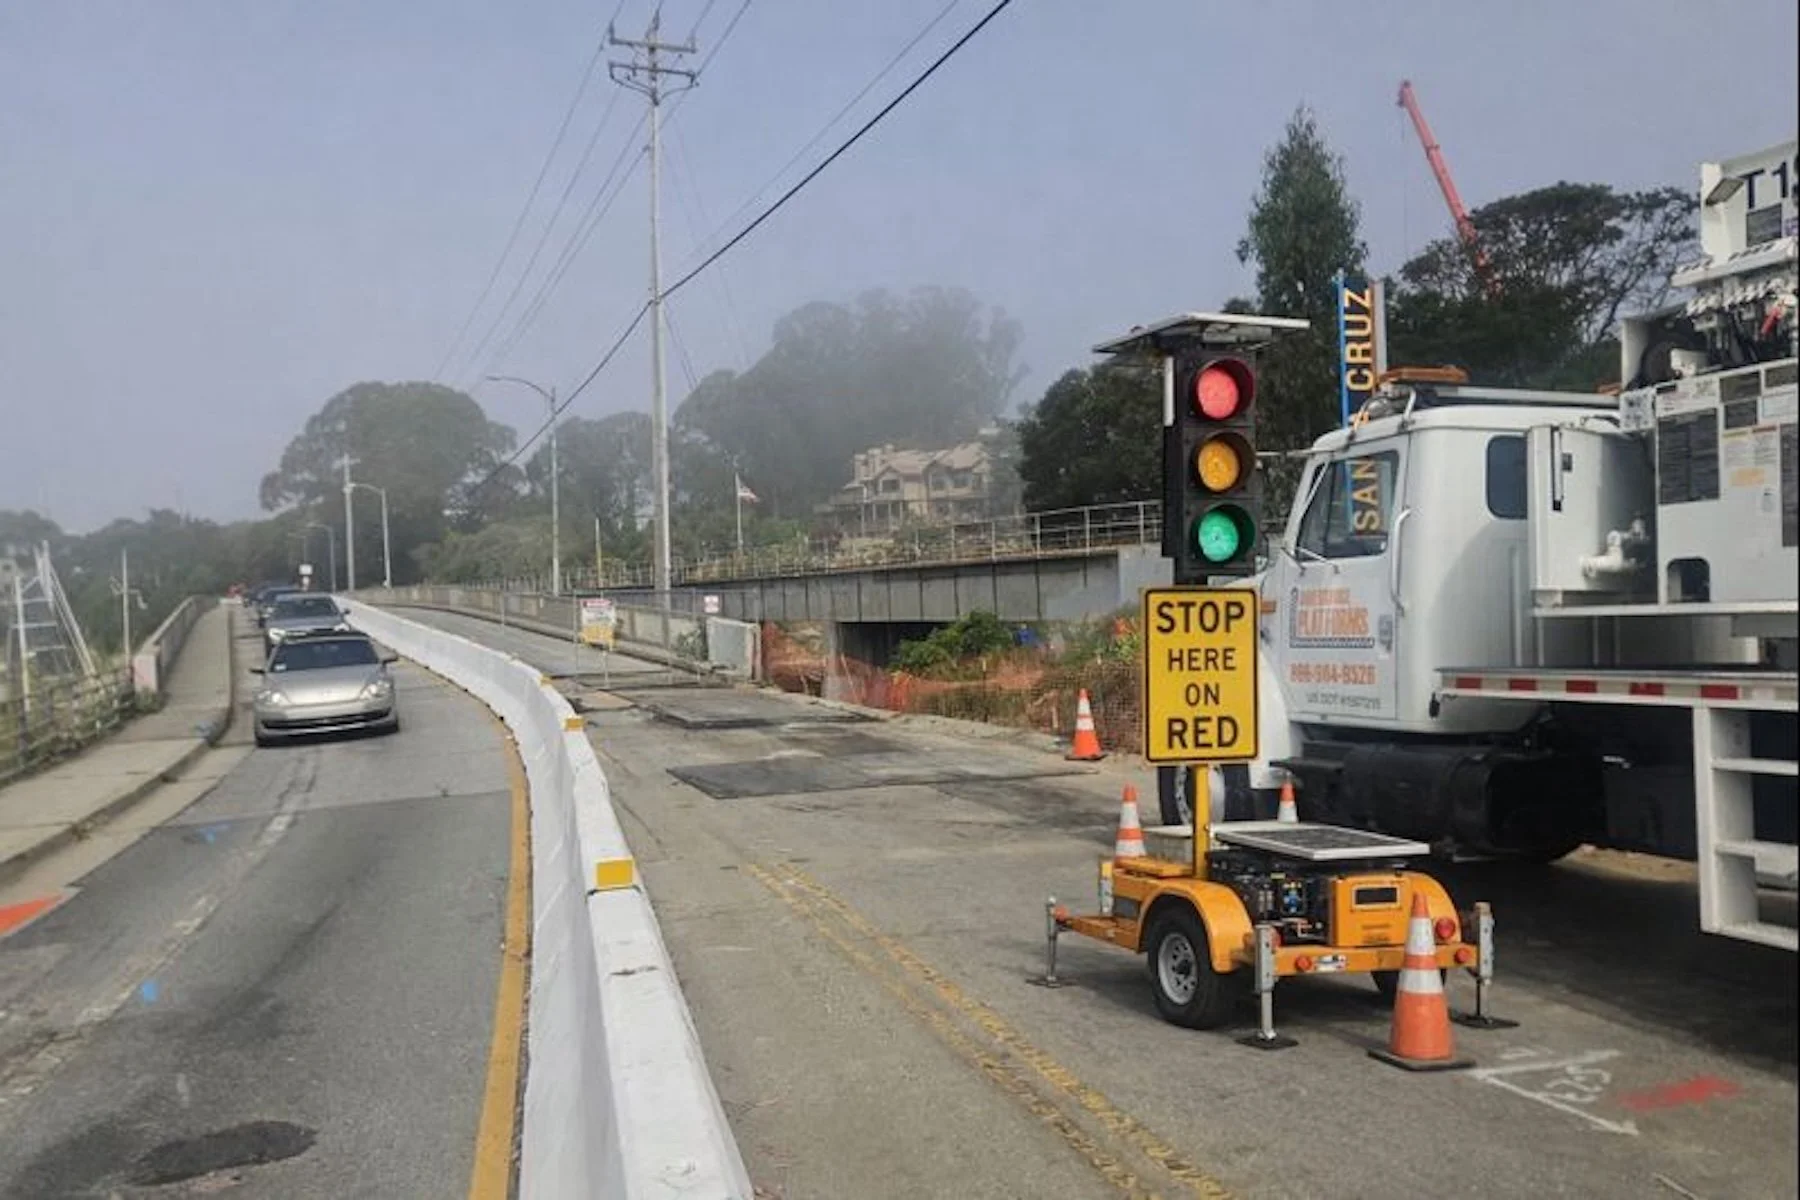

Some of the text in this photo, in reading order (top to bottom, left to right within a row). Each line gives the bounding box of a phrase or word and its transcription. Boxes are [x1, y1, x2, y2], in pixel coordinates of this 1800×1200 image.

[1344, 287, 1374, 391] CRUZ
[1156, 601, 1245, 633] STOP
[1168, 648, 1237, 671] HERE
[1185, 682, 1220, 707] ON
[1168, 716, 1239, 749] RED
